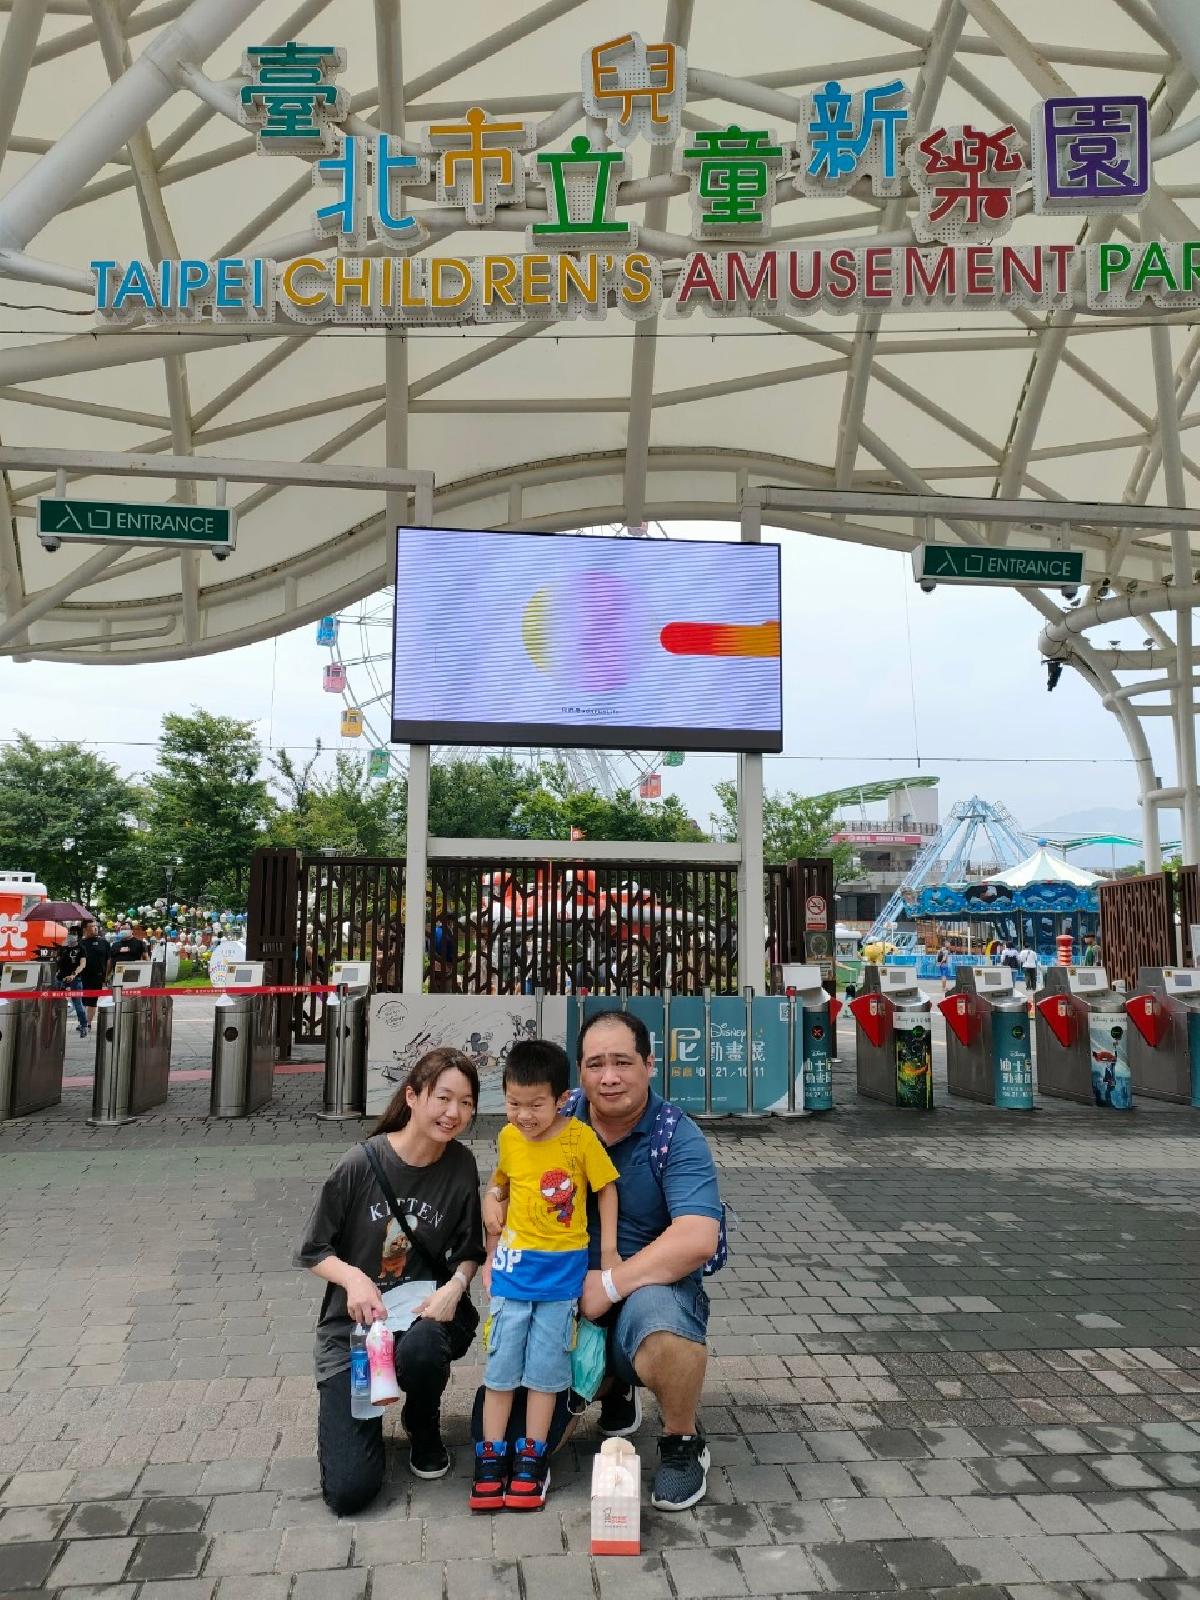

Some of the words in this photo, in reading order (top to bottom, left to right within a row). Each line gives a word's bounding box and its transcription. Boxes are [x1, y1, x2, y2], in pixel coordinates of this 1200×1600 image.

[91, 258, 264, 309] TAIPEI
[283, 254, 652, 307] CHILDREN'S
[679, 245, 1075, 302] AMUSEMENT
[56, 503, 111, 531] 入口
[116, 512, 214, 534] ENTRANCE
[936, 550, 984, 575] 入口
[987, 556, 1072, 577] ENTRANCE
